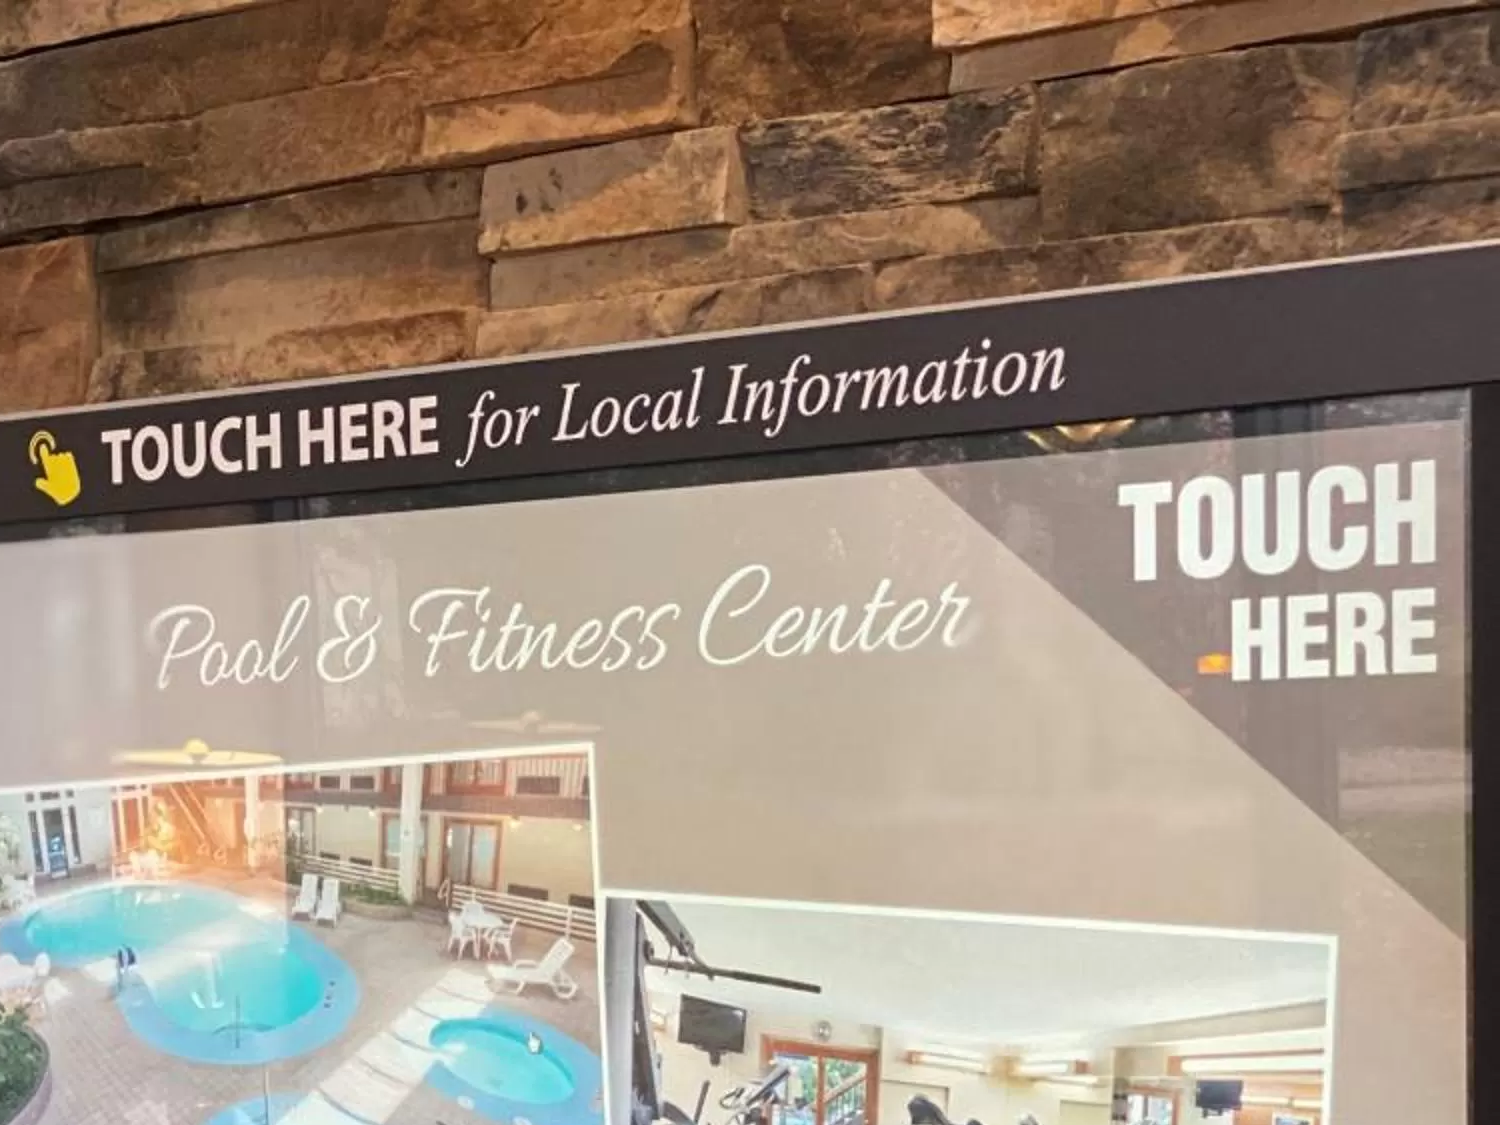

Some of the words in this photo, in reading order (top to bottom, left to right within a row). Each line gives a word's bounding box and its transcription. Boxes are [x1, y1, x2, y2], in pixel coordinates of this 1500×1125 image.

[101, 412, 282, 485] TOUCH
[298, 395, 439, 466] HERE
[456, 391, 540, 468] for
[551, 366, 706, 441] Local
[717, 338, 1067, 438] Information
[1118, 460, 1437, 581] TOUCH
[148, 595, 310, 690] Pool
[317, 595, 382, 683] &
[409, 586, 681, 677] Fitness
[699, 564, 970, 666] Center
[1231, 587, 1438, 681] HERE
